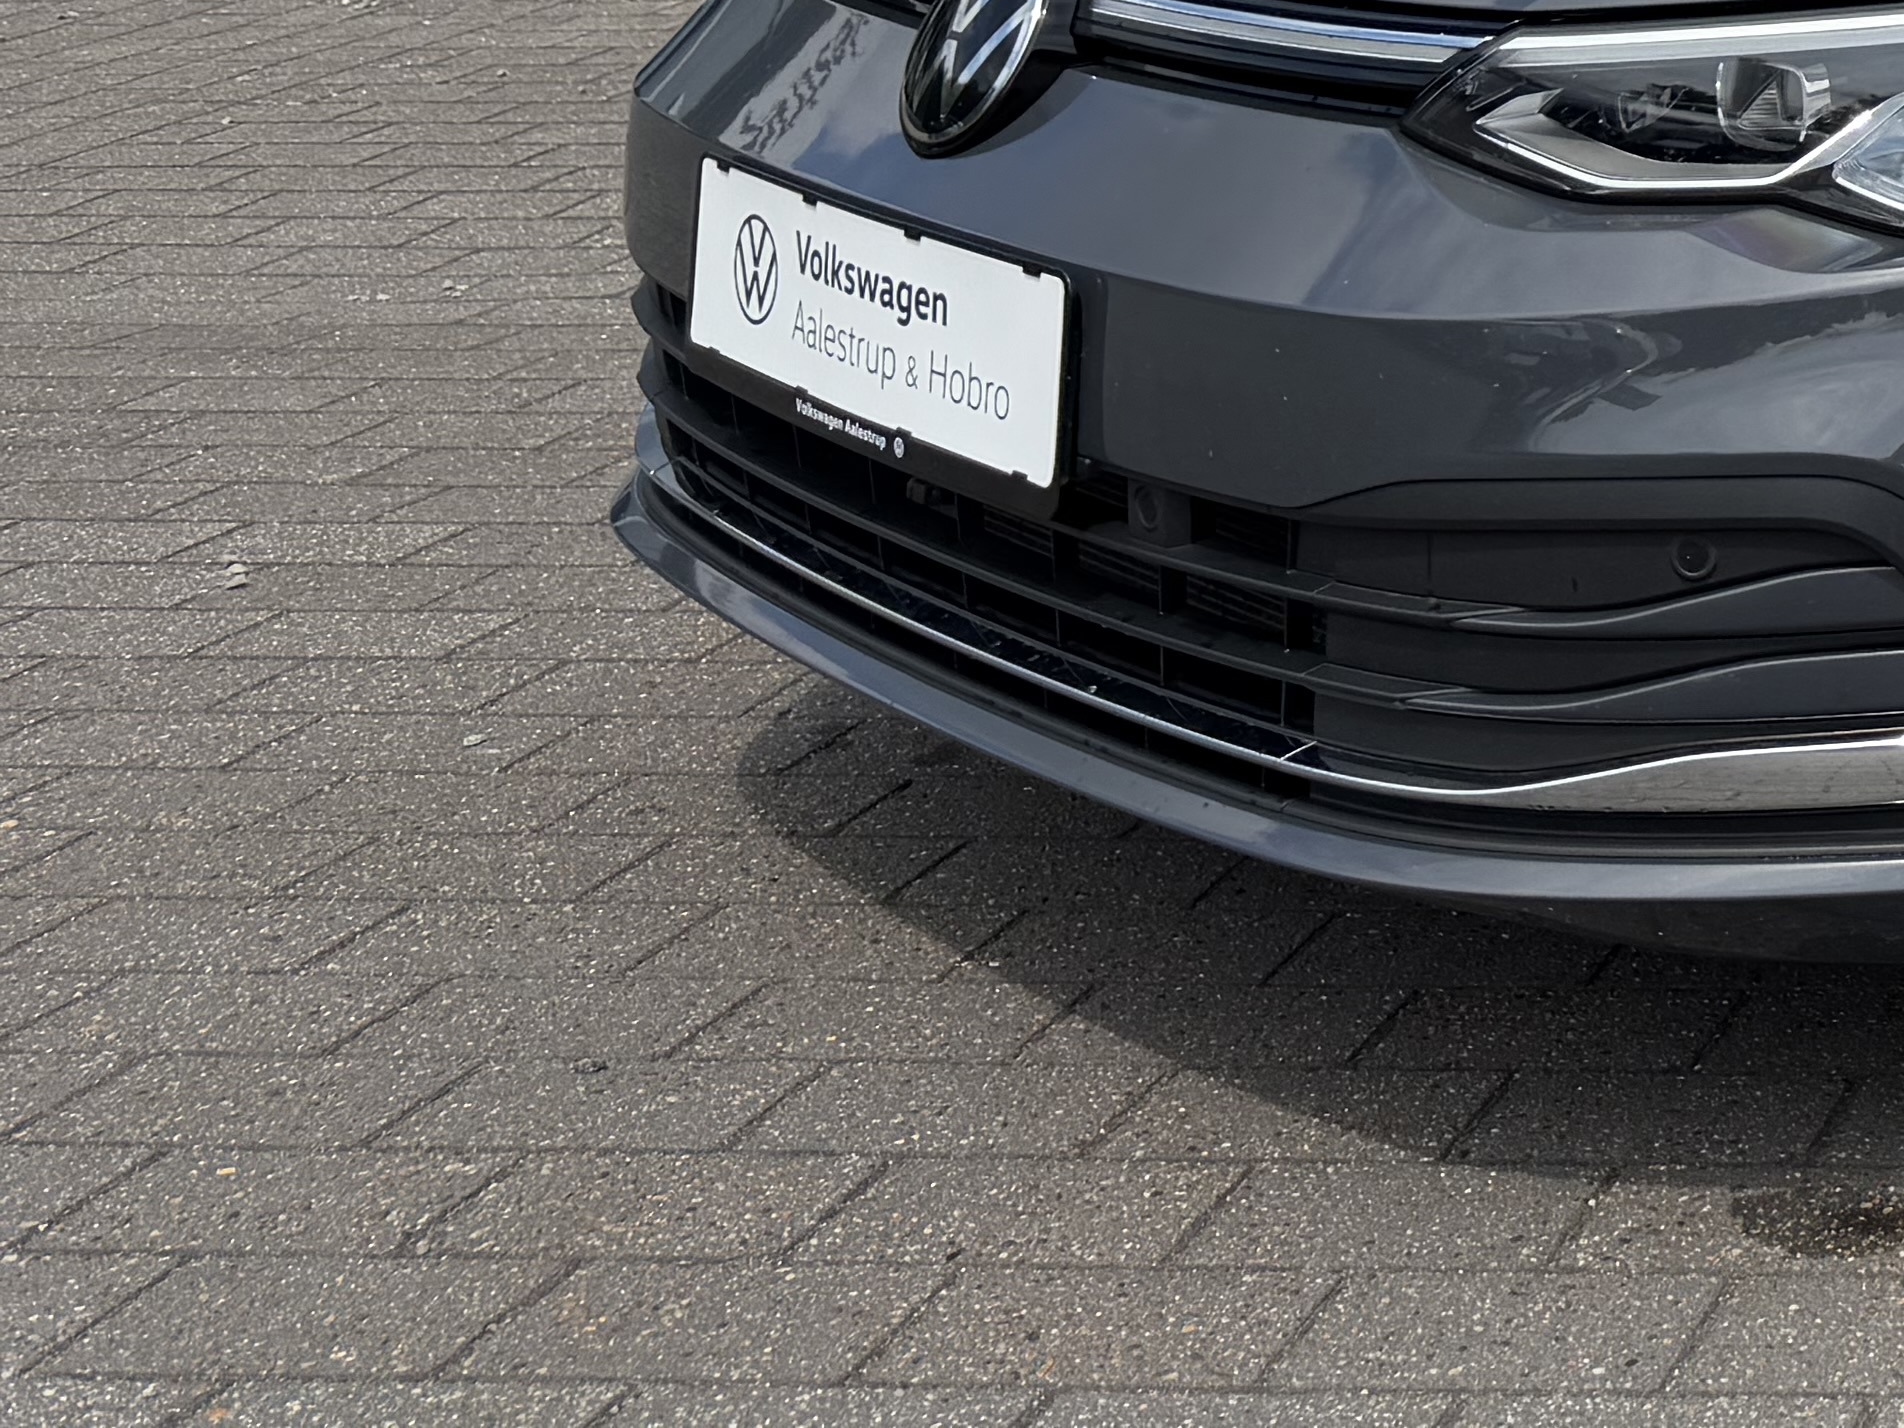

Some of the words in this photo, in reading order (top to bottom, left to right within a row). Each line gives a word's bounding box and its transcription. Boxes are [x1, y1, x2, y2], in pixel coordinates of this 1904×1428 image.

[734, 214, 778, 326] VW
[796, 229, 948, 327] Volkswagen
[792, 299, 896, 390] Aalestrup
[905, 355, 918, 390] &
[929, 349, 1010, 421] Hobro
[795, 397, 844, 431] Volkswagen
[844, 418, 887, 451] Aalestrup
